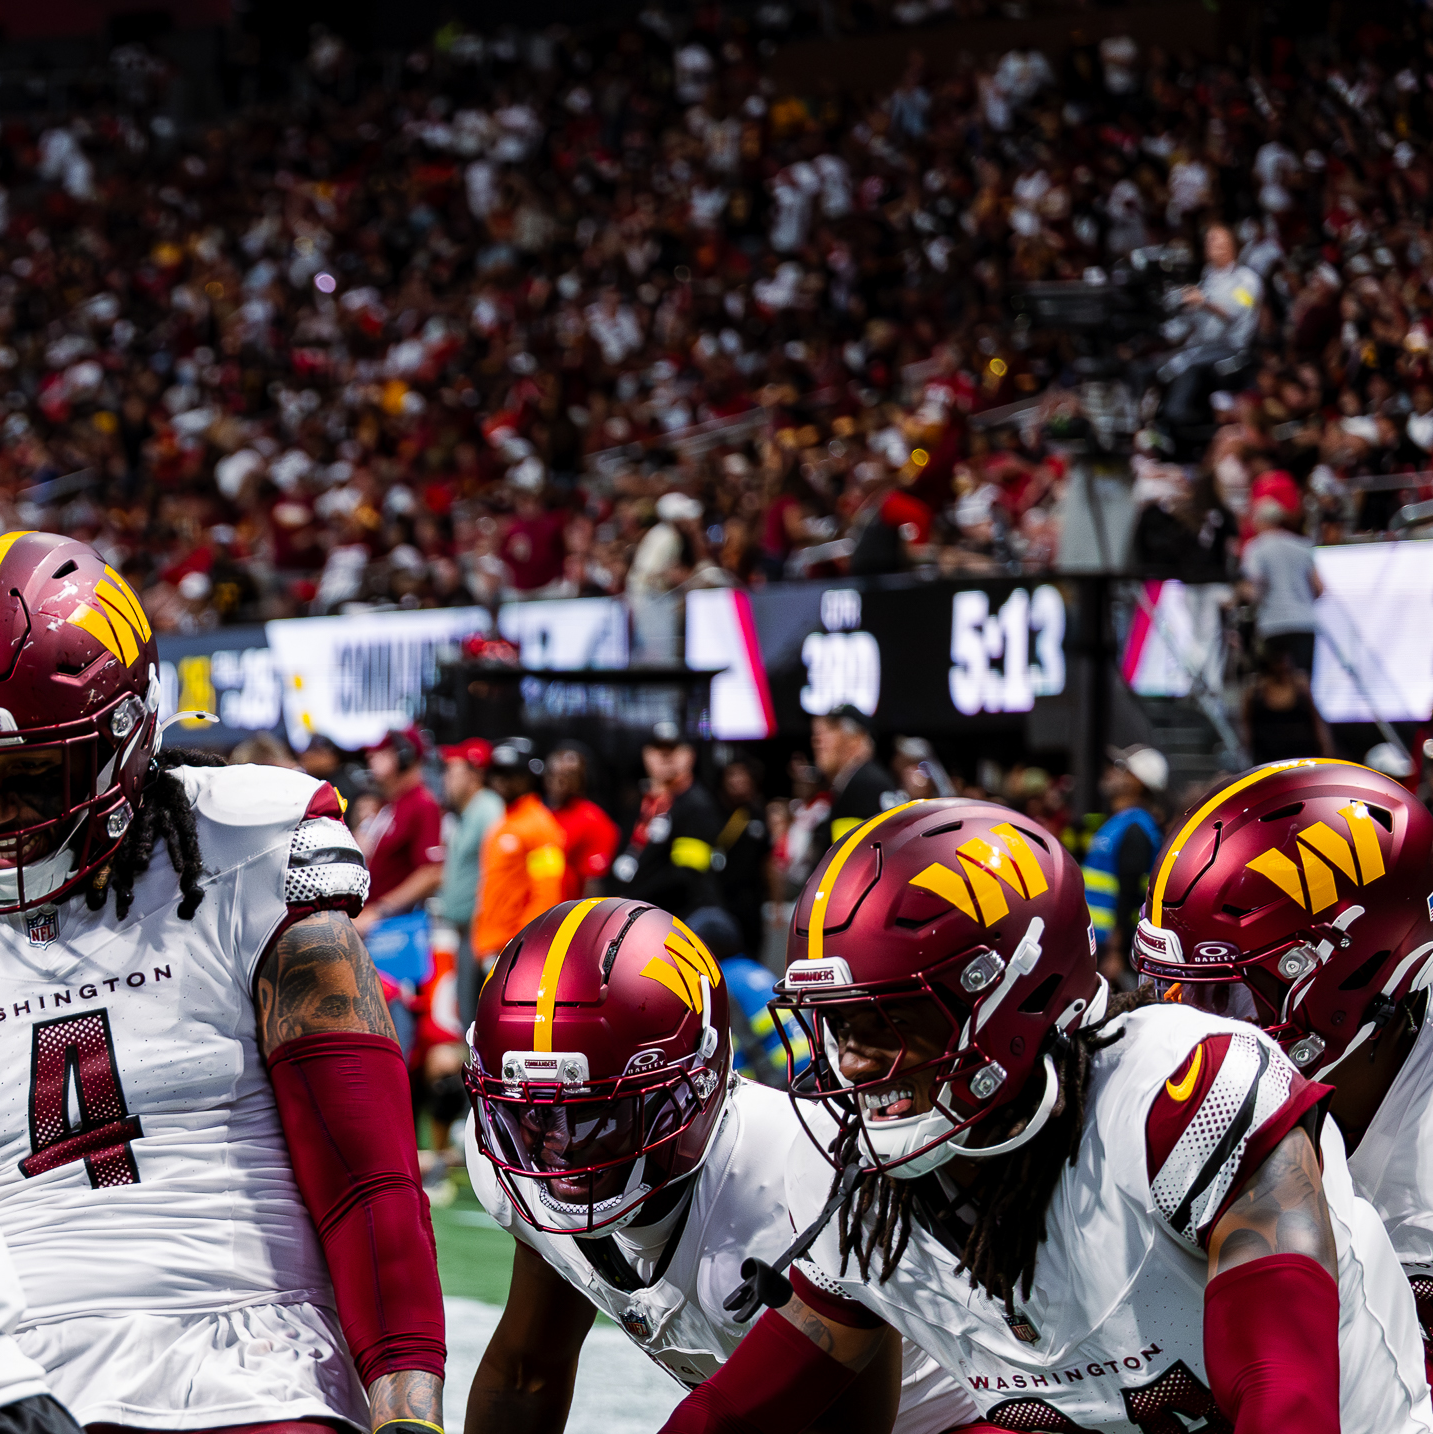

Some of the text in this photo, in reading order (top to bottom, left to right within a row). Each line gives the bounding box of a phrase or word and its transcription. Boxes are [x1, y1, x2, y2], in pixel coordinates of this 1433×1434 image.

[949, 583, 1066, 717] 5:13
[29, 925, 56, 942] NFL
[627, 1059, 666, 1075] OAKLEY
[18, 1007, 144, 1190] 4
[967, 1342, 1164, 1391] WASHINGTON
